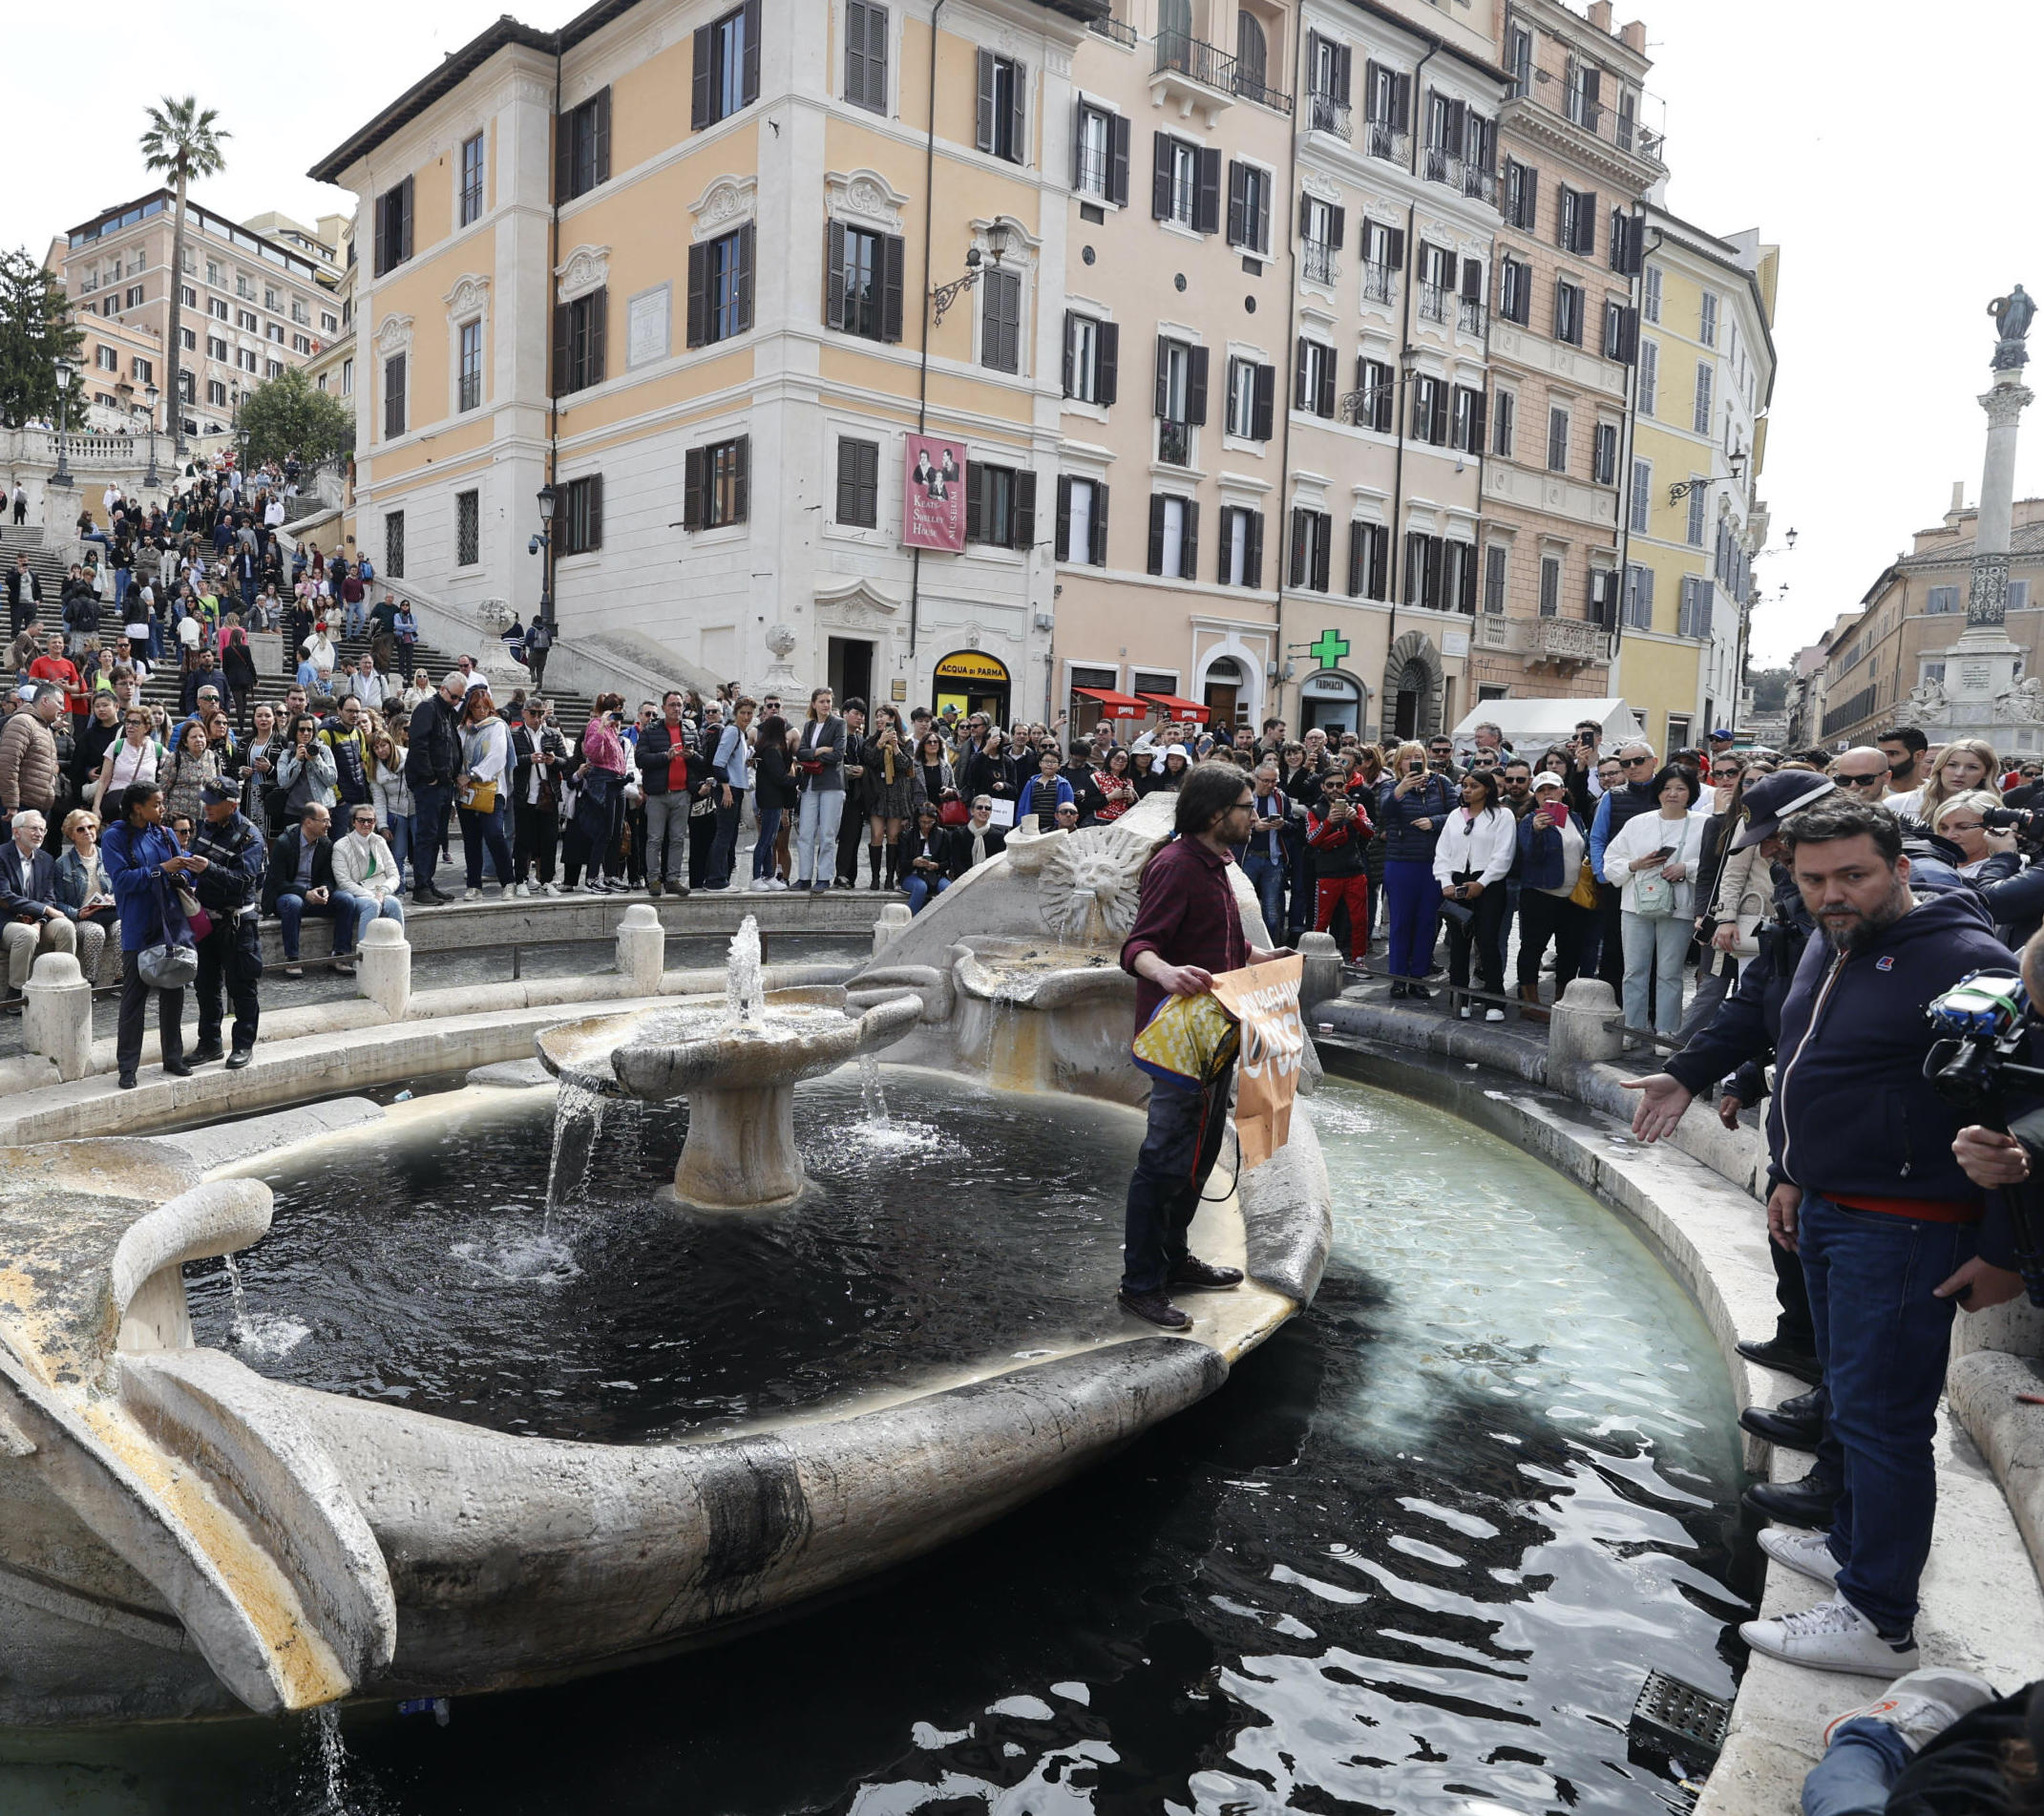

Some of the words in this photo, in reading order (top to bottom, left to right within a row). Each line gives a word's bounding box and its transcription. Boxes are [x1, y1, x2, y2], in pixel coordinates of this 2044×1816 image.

[948, 490, 958, 540] MUSEUM
[942, 665, 967, 673] ACQUA
[977, 667, 1002, 676] PARMA
[1316, 679, 1344, 691] FARMACIA
